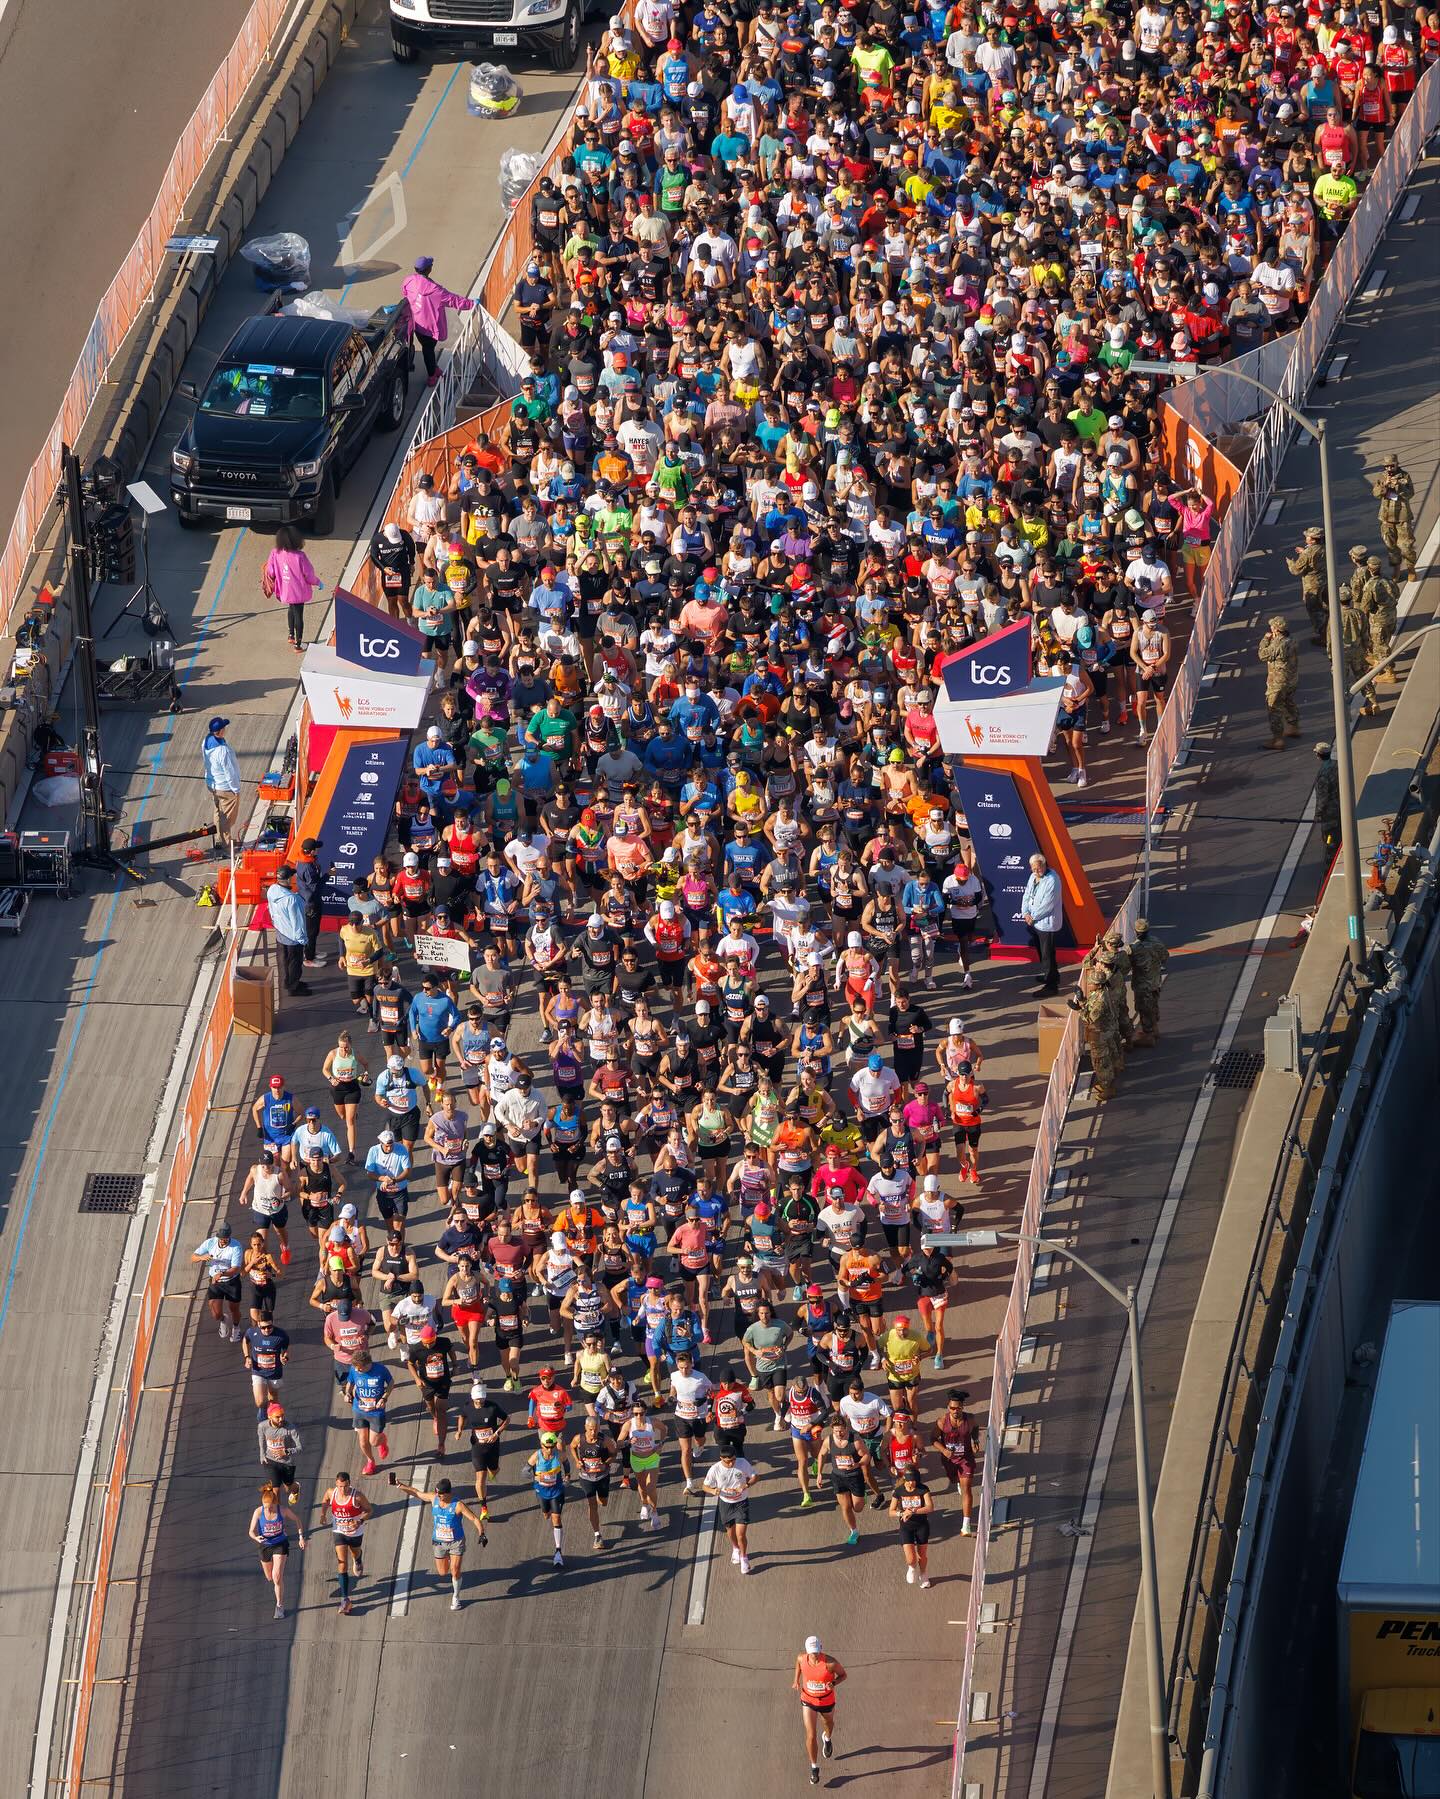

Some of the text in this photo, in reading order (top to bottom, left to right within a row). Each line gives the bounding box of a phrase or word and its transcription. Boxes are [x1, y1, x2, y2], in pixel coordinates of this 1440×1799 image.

[221, 471, 257, 480] TOYOTA
[359, 633, 400, 658] tcs
[971, 660, 1011, 685] tcs
